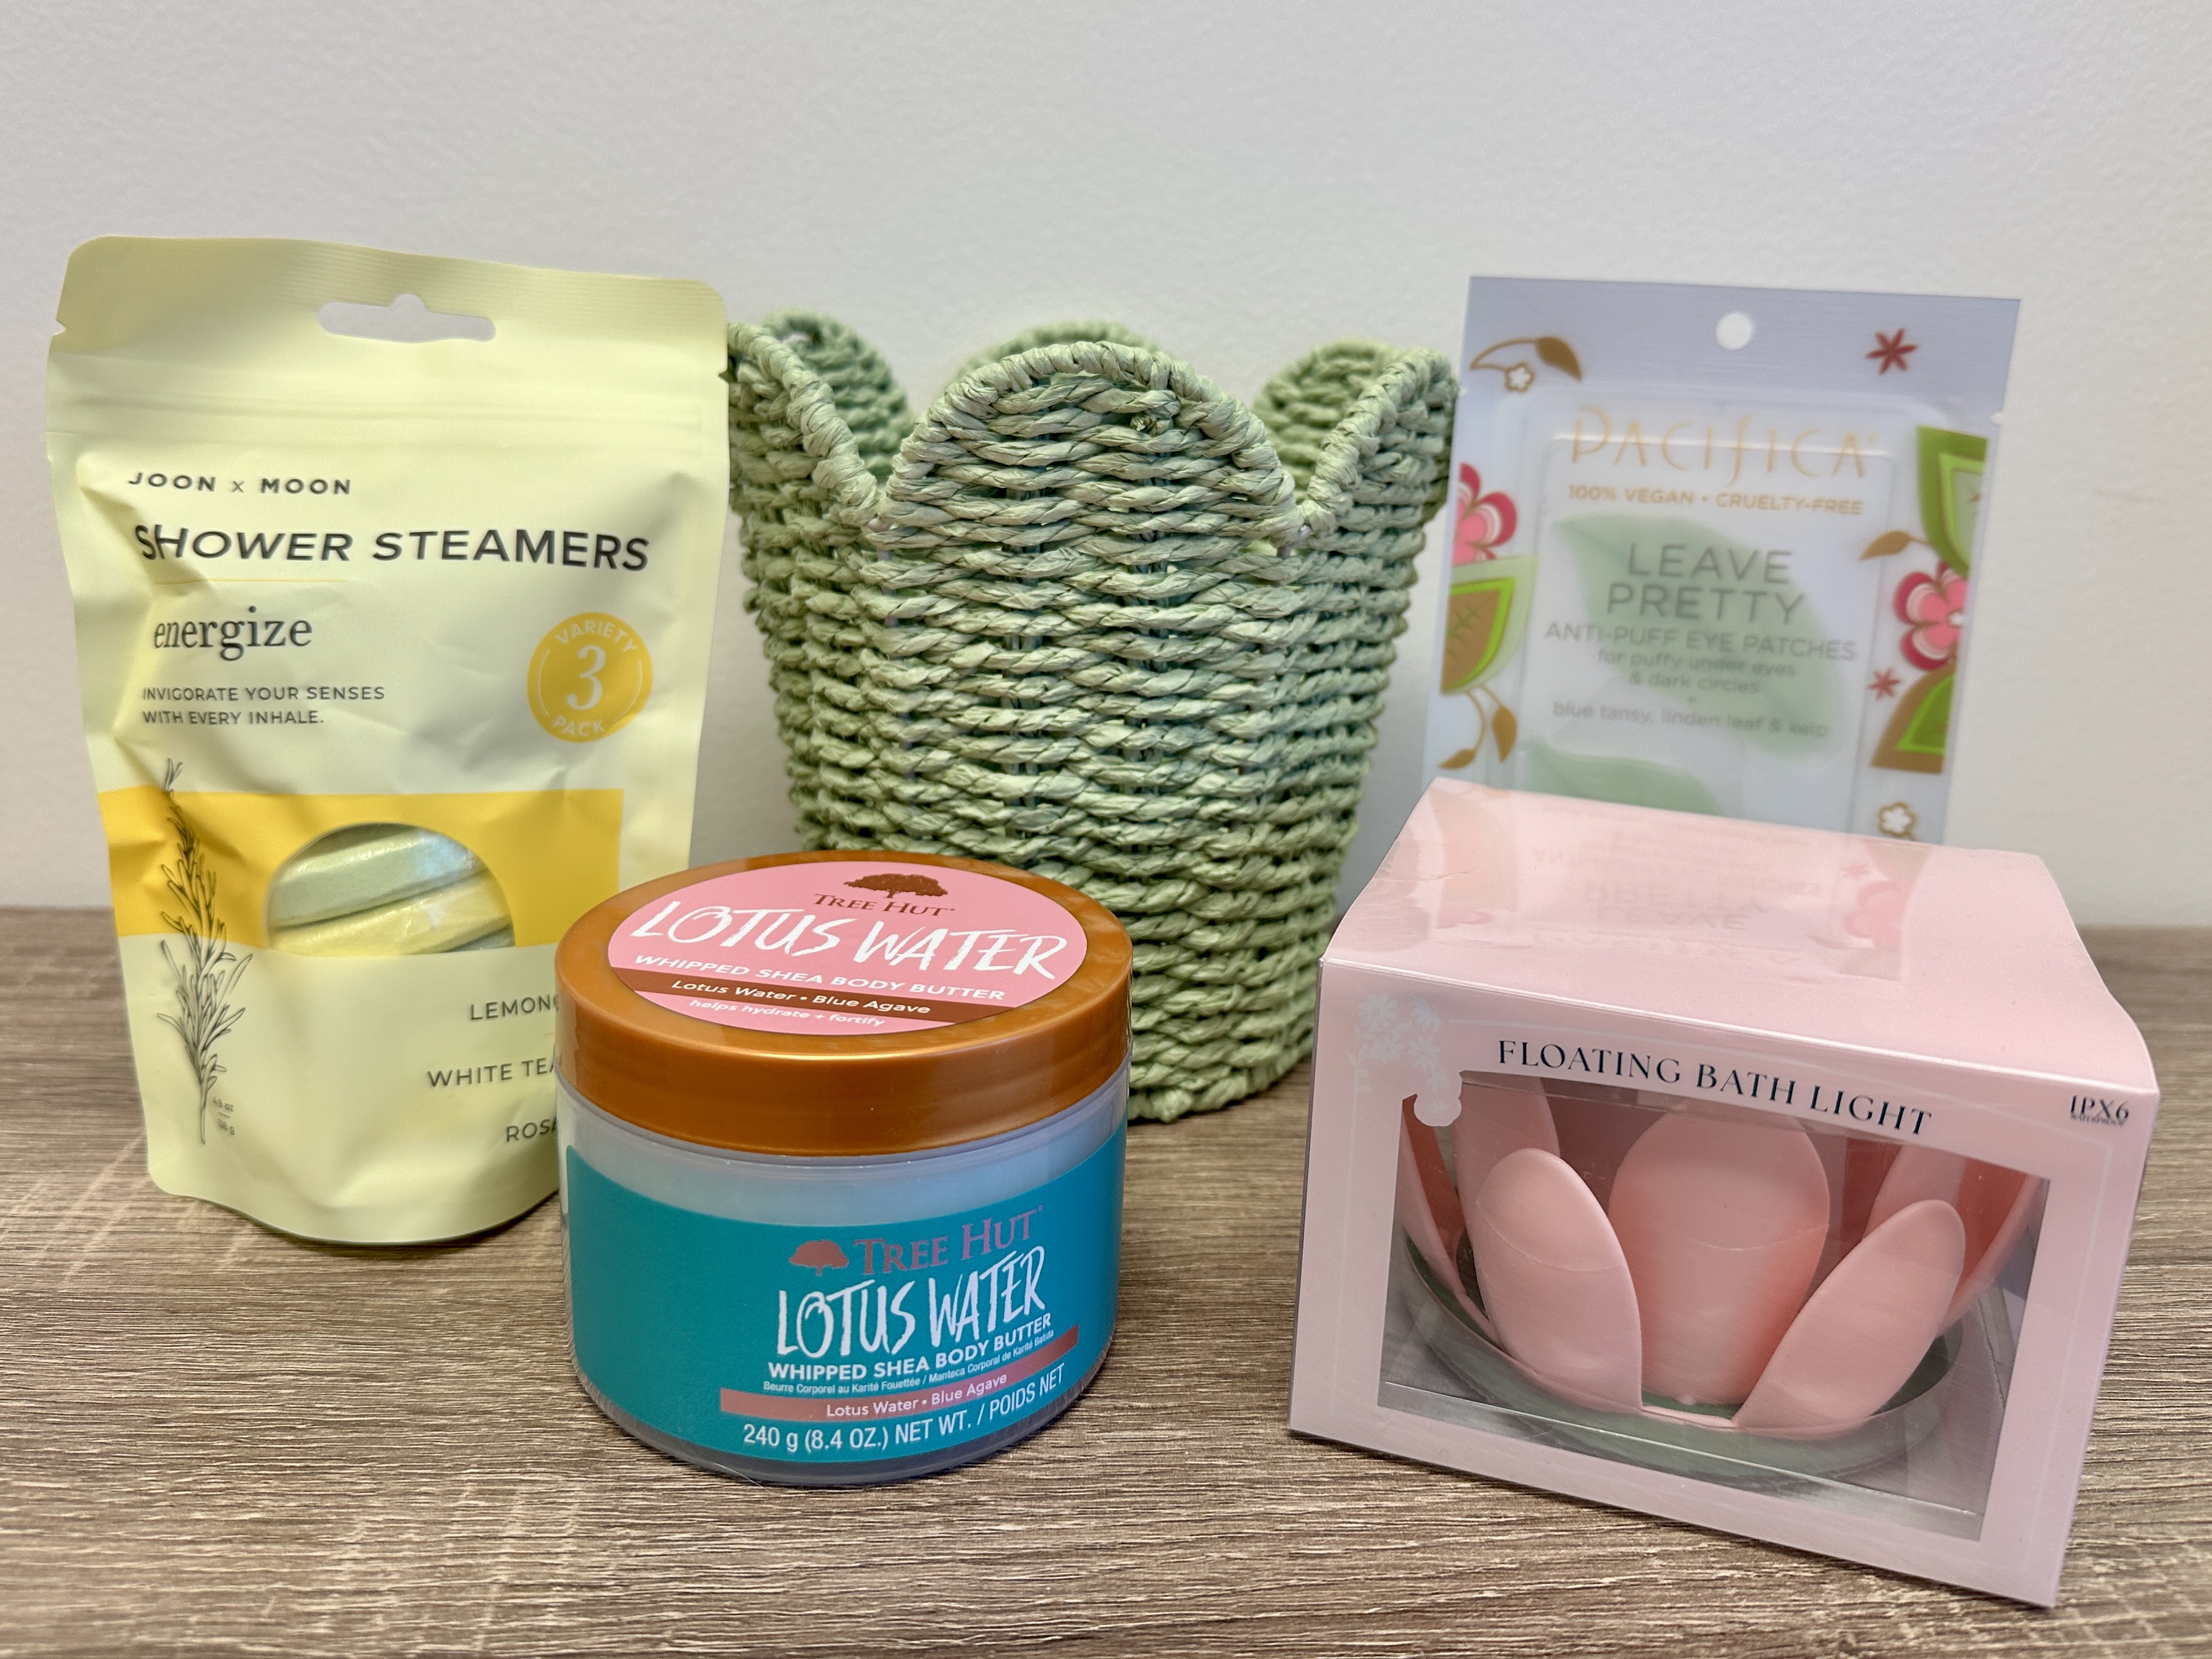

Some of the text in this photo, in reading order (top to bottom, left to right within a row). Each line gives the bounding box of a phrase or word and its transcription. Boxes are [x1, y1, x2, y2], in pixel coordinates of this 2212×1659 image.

[1570, 404, 1867, 486] PACIFICA
[128, 472, 216, 492] JOON
[261, 477, 351, 495] MOON
[1568, 485, 1864, 516] 100% VEGAN CRUELTY-FREE
[135, 524, 650, 571] SHOWER STEAMERS
[1627, 542, 1792, 584] LEAVE
[1606, 582, 1805, 626] PRETTY
[154, 606, 312, 661] energize
[556, 620, 639, 652] VARIETY
[1545, 622, 1857, 662] ANTI-PUFF EYE PATCHES
[566, 644, 606, 710] 3
[1598, 647, 1623, 665] for
[1630, 650, 1683, 670] puffy
[143, 686, 385, 701] INVIGORATE YOUR SENSES
[1647, 671, 1690, 689] dark
[1697, 677, 1759, 695] circles
[143, 710, 324, 724] WITH EVERY INHALE.
[553, 715, 605, 736] PACK
[1552, 701, 1594, 719] blue
[813, 893, 877, 910] TREE
[631, 901, 1067, 980] LOTUS WATER
[635, 956, 1005, 1001] WHIPPED SHEA BODY BUTTER
[672, 980, 931, 1016] Lotus Water Blue Agave
[689, 998, 739, 1014] helps
[741, 1004, 811, 1020] hydrate
[829, 1014, 885, 1028] fortify
[427, 1063, 513, 1087] WHITE
[1497, 1039, 1932, 1137] FLOATING BATH LIGHT
[2071, 1095, 2129, 1122] IPX6
[853, 1236, 949, 1275] TREE
[777, 1246, 1045, 1358] LOTUS WATER
[763, 1380, 794, 1392] Beurre
[796, 1383, 836, 1395] Corporel
[852, 1382, 879, 1393] Karité
[881, 1377, 921, 1390] Fouettée
[929, 1367, 965, 1383] Manteca
[967, 1354, 1000, 1373] Corporal
[1002, 1351, 1012, 1361] de
[1013, 1340, 1033, 1357] Karité
[1034, 1329, 1054, 1346] Batida
[768, 1312, 1051, 1380] WHIPPED SHEA BODY BUTTER
[744, 1424, 780, 1447] 240
[786, 1431, 798, 1452] g
[805, 1428, 843, 1453] (8.4
[849, 1426, 889, 1450] OZ.)
[895, 1418, 934, 1445] NET
[939, 1409, 971, 1435] WT.
[990, 1385, 1036, 1418] POIDS
[1039, 1363, 1065, 1394] NET
[827, 1374, 1007, 1418] Lotus Water Blue Agave
